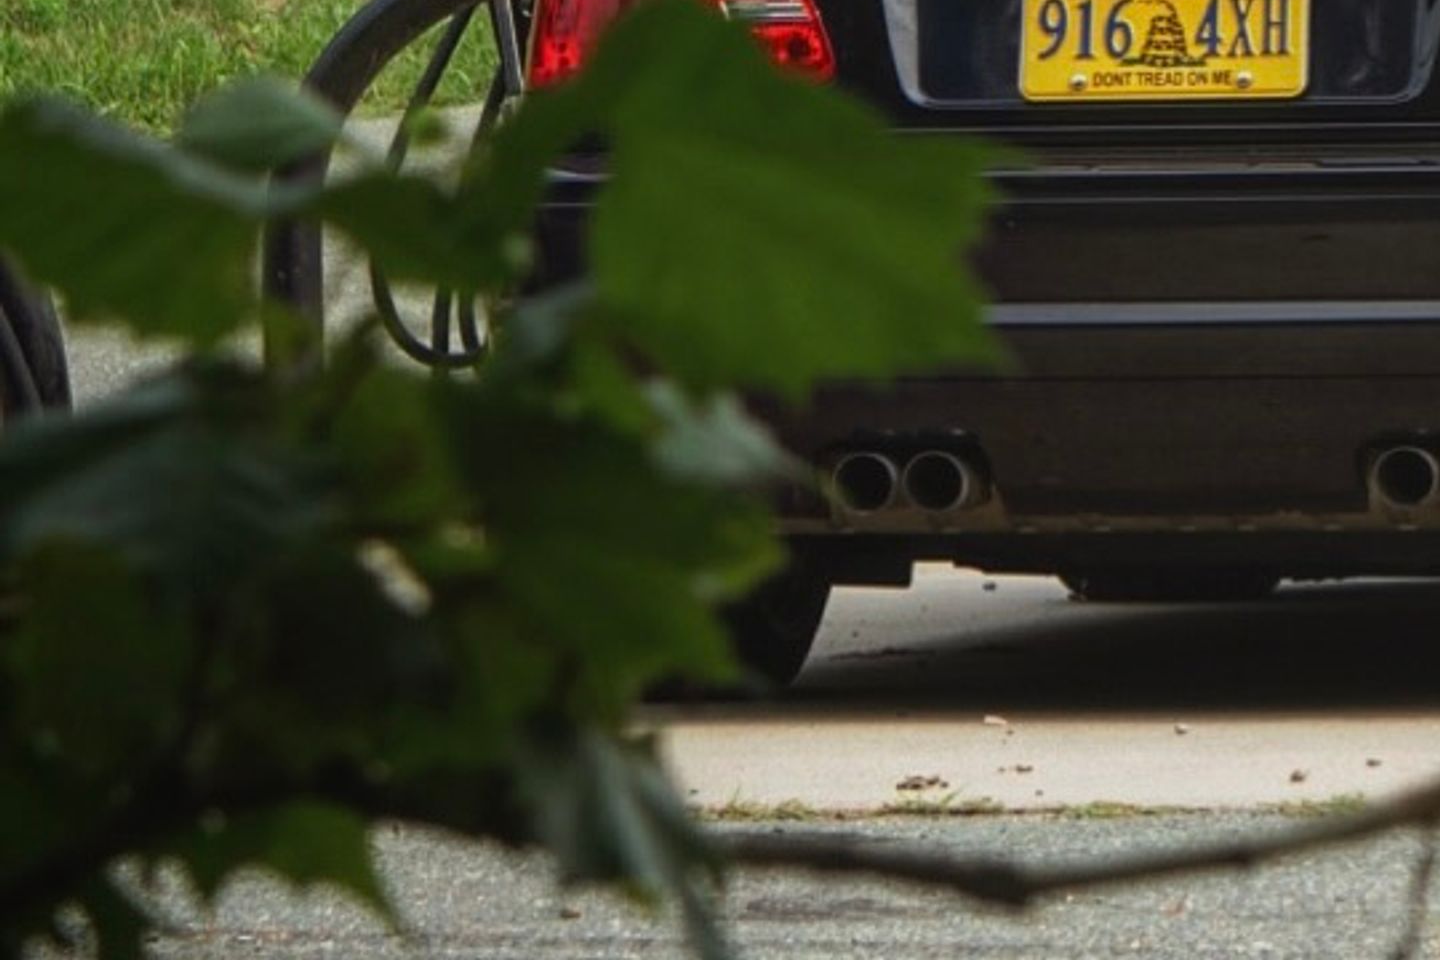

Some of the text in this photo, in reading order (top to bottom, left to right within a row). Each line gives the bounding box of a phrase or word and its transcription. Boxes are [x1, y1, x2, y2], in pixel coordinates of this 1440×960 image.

[1093, 69, 1231, 87] DONT TREAD ON ME
